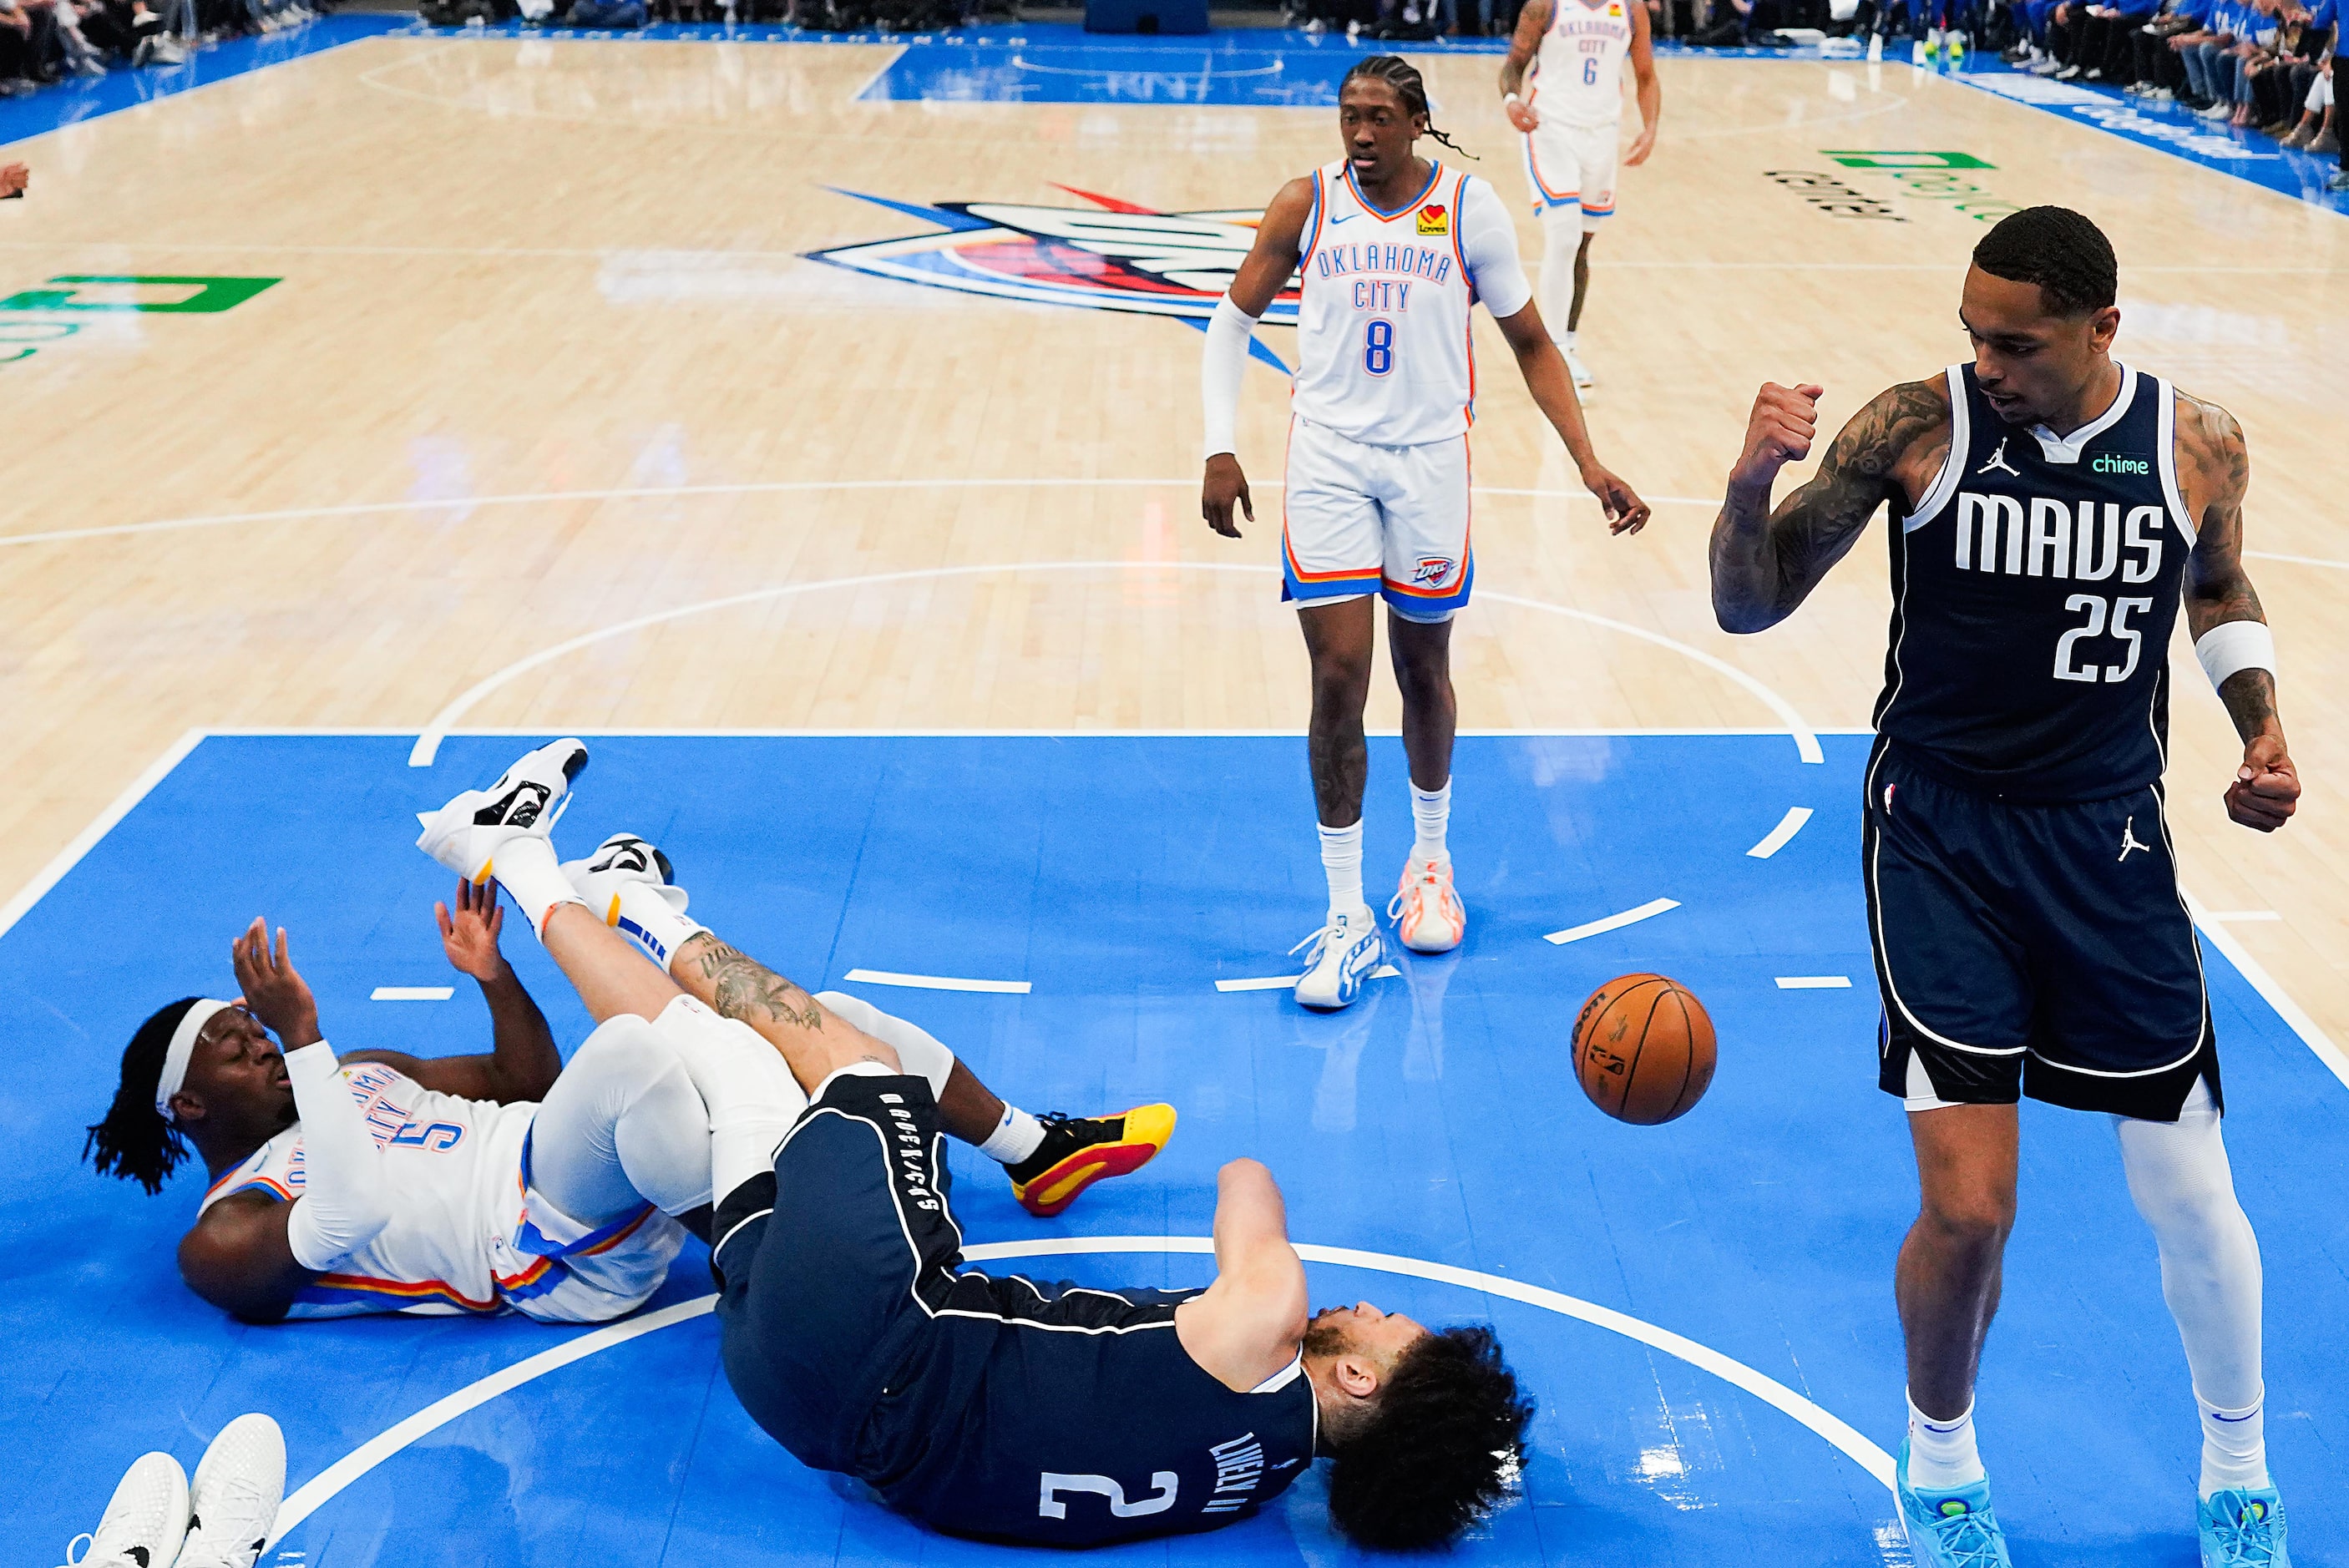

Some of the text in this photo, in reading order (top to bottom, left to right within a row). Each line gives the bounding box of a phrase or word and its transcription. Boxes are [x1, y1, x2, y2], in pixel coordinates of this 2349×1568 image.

[1578, 39, 1607, 54] CITY
[1583, 57, 1598, 86] 6
[1317, 241, 1454, 286] OKLAHOMA
[1352, 279, 1412, 312] CITY
[1362, 316, 1396, 377] 8
[2092, 453, 2149, 475] chime
[1955, 491, 2164, 584] MAVS
[2053, 593, 2154, 683] 25
[388, 1120, 468, 1154] 5
[1208, 1432, 1265, 1494] LIVELY
[1039, 1470, 1179, 1520] 2
